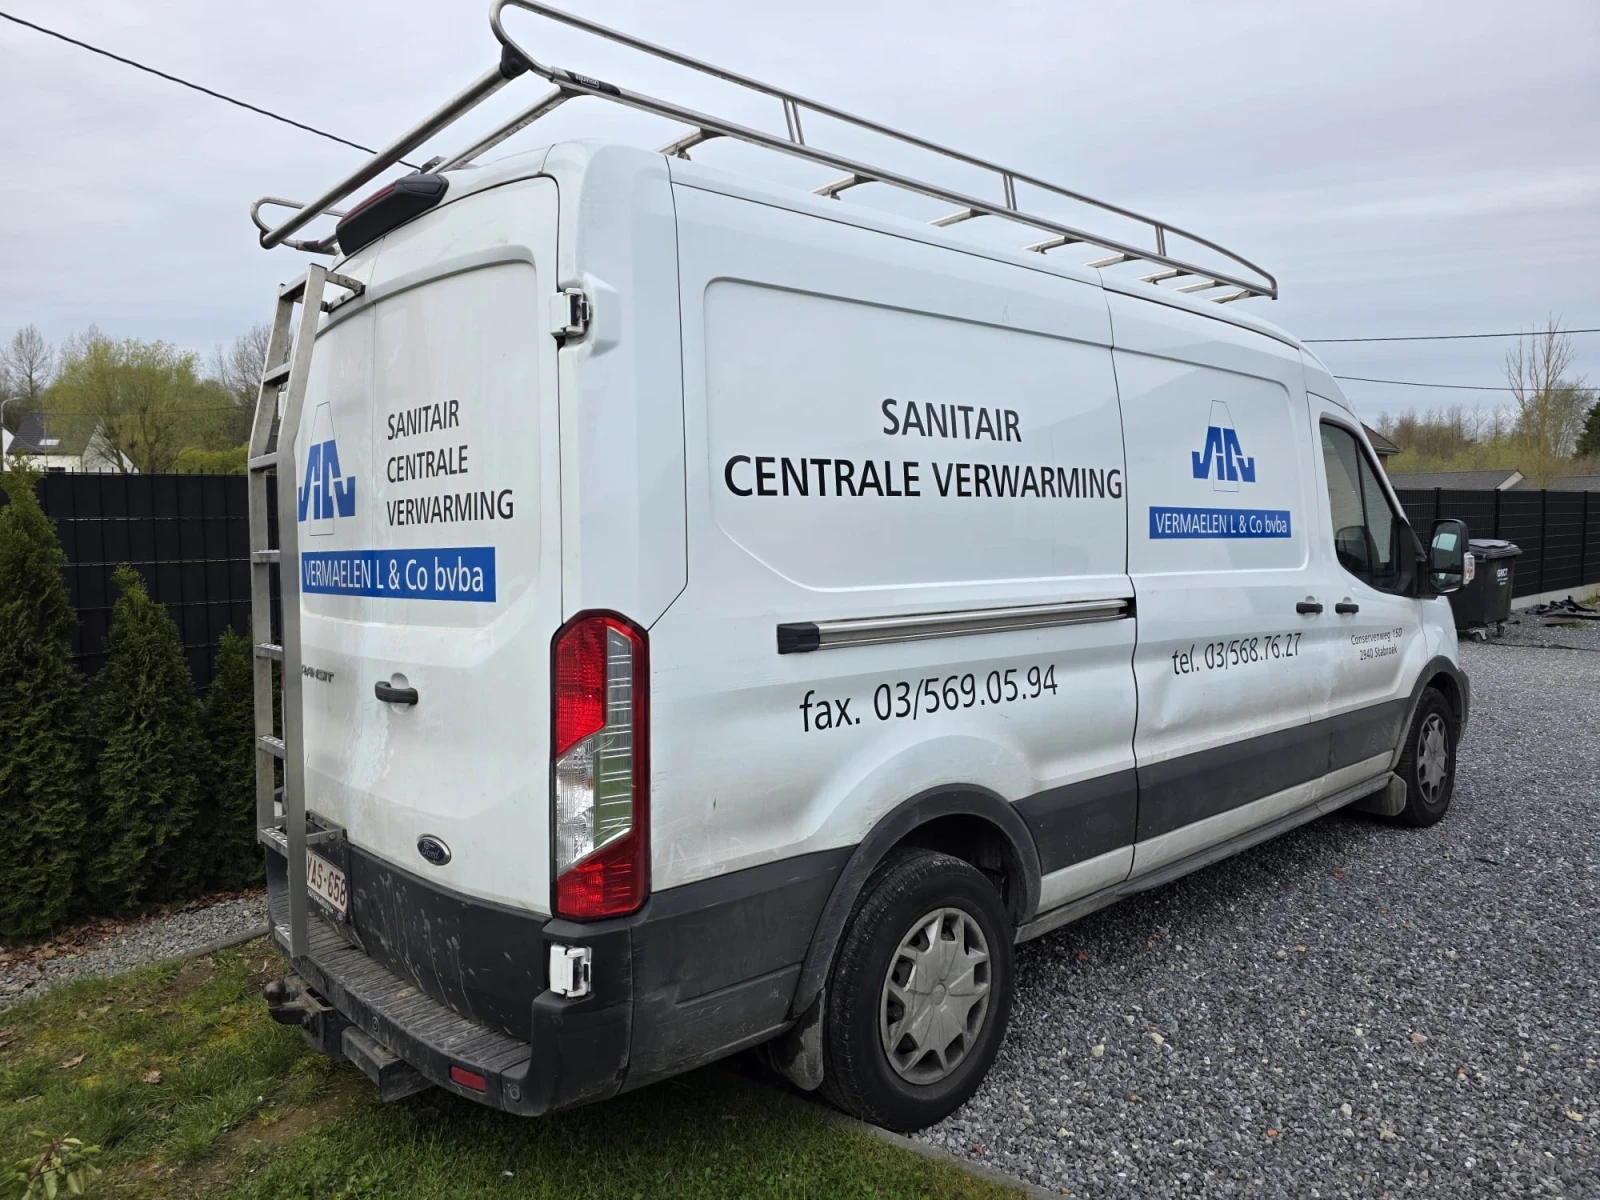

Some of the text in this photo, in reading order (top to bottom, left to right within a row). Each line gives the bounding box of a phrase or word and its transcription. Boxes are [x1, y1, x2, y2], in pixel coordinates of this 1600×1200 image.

[387, 399, 460, 440] SANITAIR
[882, 398, 1022, 442] SANITAIR
[387, 445, 468, 483] CENTRALE
[724, 454, 1123, 499] CENTRALE VERWARMING
[386, 489, 514, 526] VERWARMING
[1155, 513, 1287, 534] VERMAELEN L & Co bvba
[304, 557, 484, 592] VERMAELEN L & Co bvba
[1172, 632, 1302, 675] tel. 03/568.76.27
[1359, 643, 1398, 661] 2940 Stabroek
[799, 664, 1059, 733] fax. 03/569.05.94
